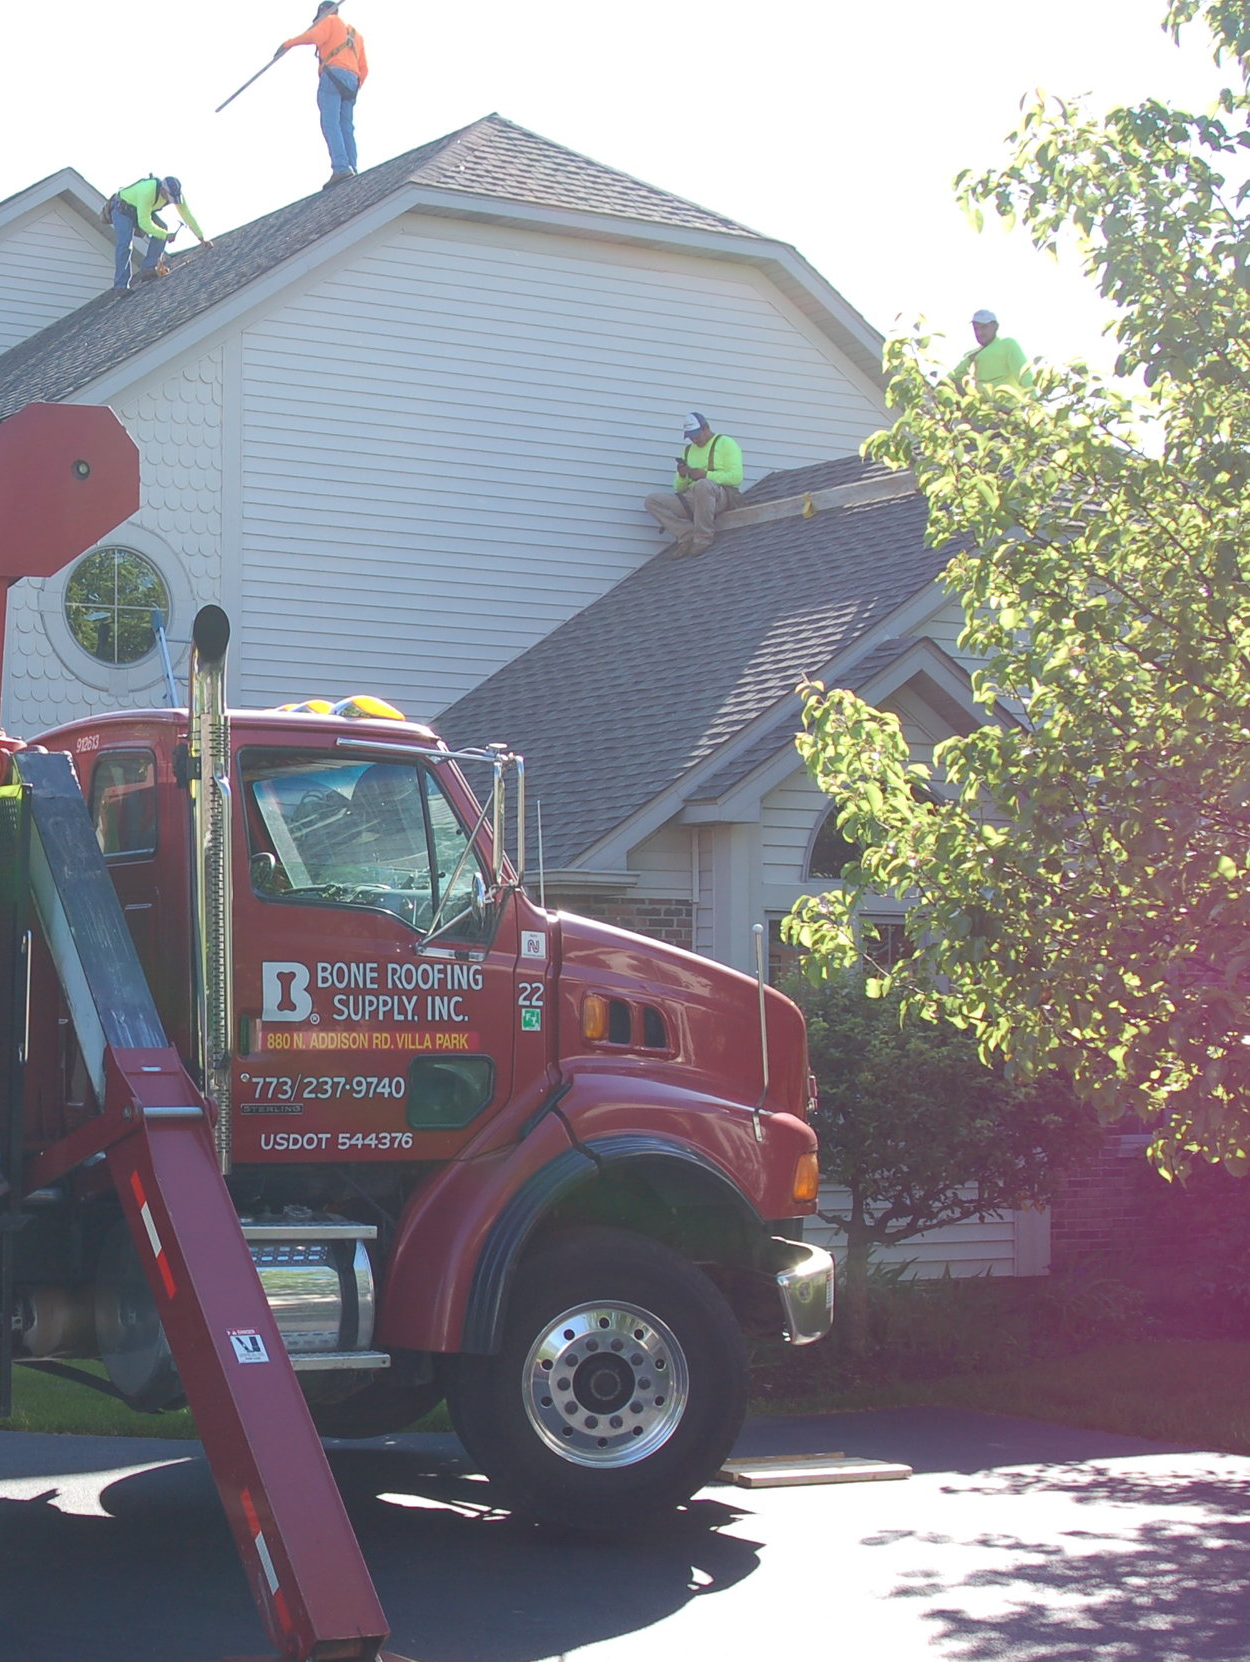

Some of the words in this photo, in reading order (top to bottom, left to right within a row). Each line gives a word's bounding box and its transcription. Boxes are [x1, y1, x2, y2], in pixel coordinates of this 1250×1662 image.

[317, 962, 379, 989] BONE
[387, 965, 483, 991] ROOFING
[518, 982, 544, 1006] 22
[333, 995, 419, 1023] SUPPLY,
[427, 996, 469, 1022] INC.
[267, 1033, 290, 1049] 880
[293, 1033, 306, 1049] N.
[309, 1033, 369, 1049] ADDISON
[372, 1033, 394, 1049] RD.
[396, 1033, 431, 1049] VILLA
[435, 1034, 469, 1049] PARK
[243, 1105, 301, 1113] STERLING
[261, 1133, 331, 1150] USDOT
[337, 1133, 413, 1149] 544376
